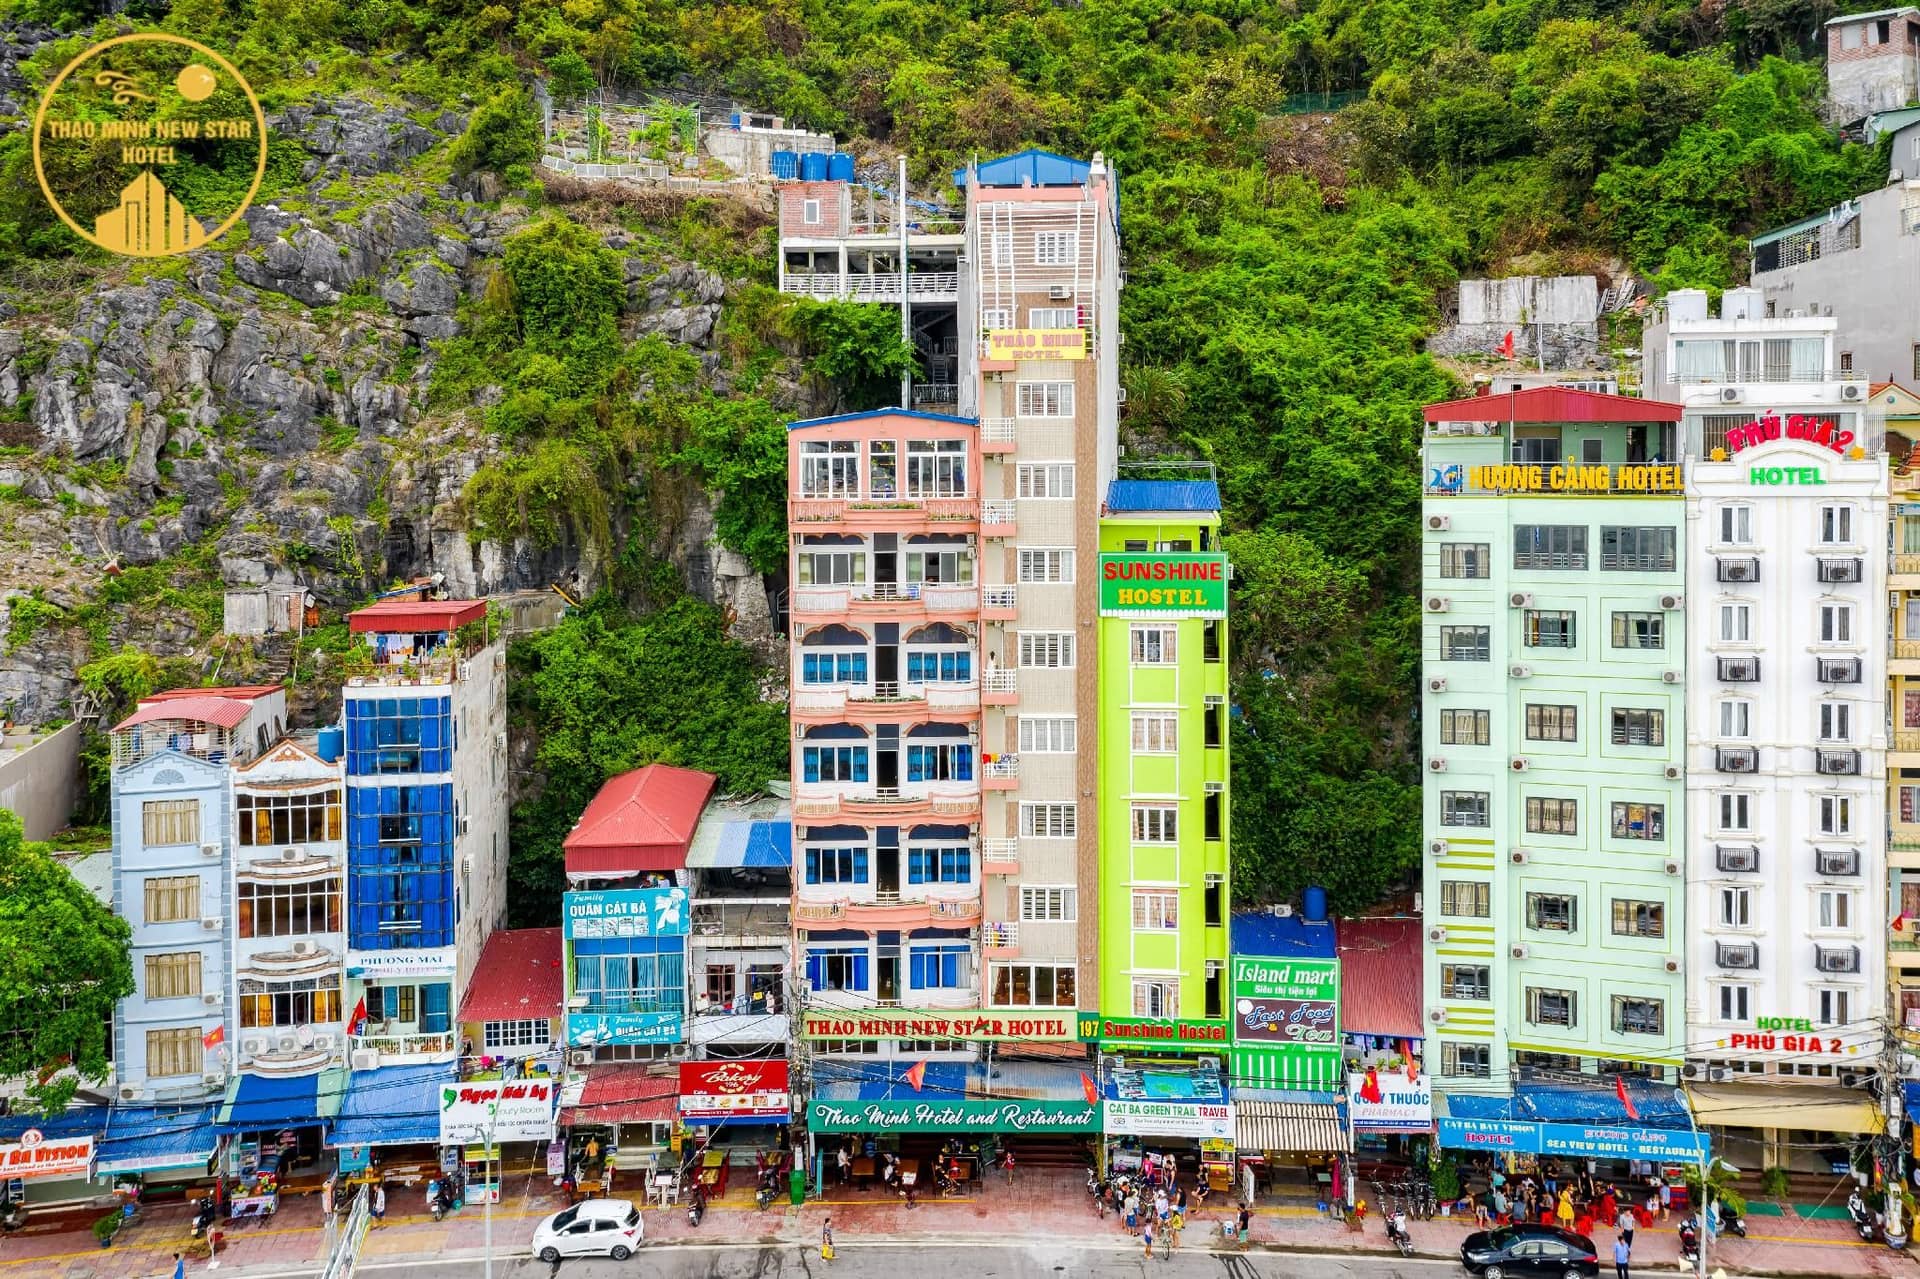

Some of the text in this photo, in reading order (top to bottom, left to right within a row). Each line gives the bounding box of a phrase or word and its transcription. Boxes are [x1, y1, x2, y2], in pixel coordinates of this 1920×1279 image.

[1042, 334, 1083, 347] MINH
[1012, 350, 1064, 359] HOTEL
[1726, 408, 1854, 455] PHÚ GIA 2
[1550, 456, 1609, 490] CẢNG
[1618, 465, 1685, 490] HOTEL
[1750, 466, 1826, 485] HOTEL
[1104, 562, 1222, 581] SUNSHINE
[1118, 589, 1208, 605] HOSTEL
[419, 955, 442, 964] MAI
[1236, 963, 1336, 985] Island mart
[1245, 1002, 1336, 1028] Fast Food
[807, 1016, 1067, 1036] THAO MINH NEW STAR HOTEL
[1079, 1020, 1099, 1037] 197
[1104, 1020, 1226, 1040] Sunshine Hostel
[1285, 1023, 1333, 1041] Tea
[1757, 1017, 1813, 1032] HOTEL
[1731, 1029, 1842, 1053] PHÚ GIA 2
[701, 1070, 762, 1086] Bakery
[1389, 1090, 1429, 1105] THUỐC
[815, 1104, 1095, 1129] Thao Minh Hotel and Restaurant
[1109, 1104, 1229, 1118] CAT BA GREEN TRAIL TRAVEL
[1480, 1122, 1499, 1131] BAY
[1465, 1132, 1514, 1145] HOTEL
[1547, 1139, 1566, 1148] SEA
[1569, 1140, 1595, 1150] VIEW
[1598, 1142, 1629, 1153] HOTEL
